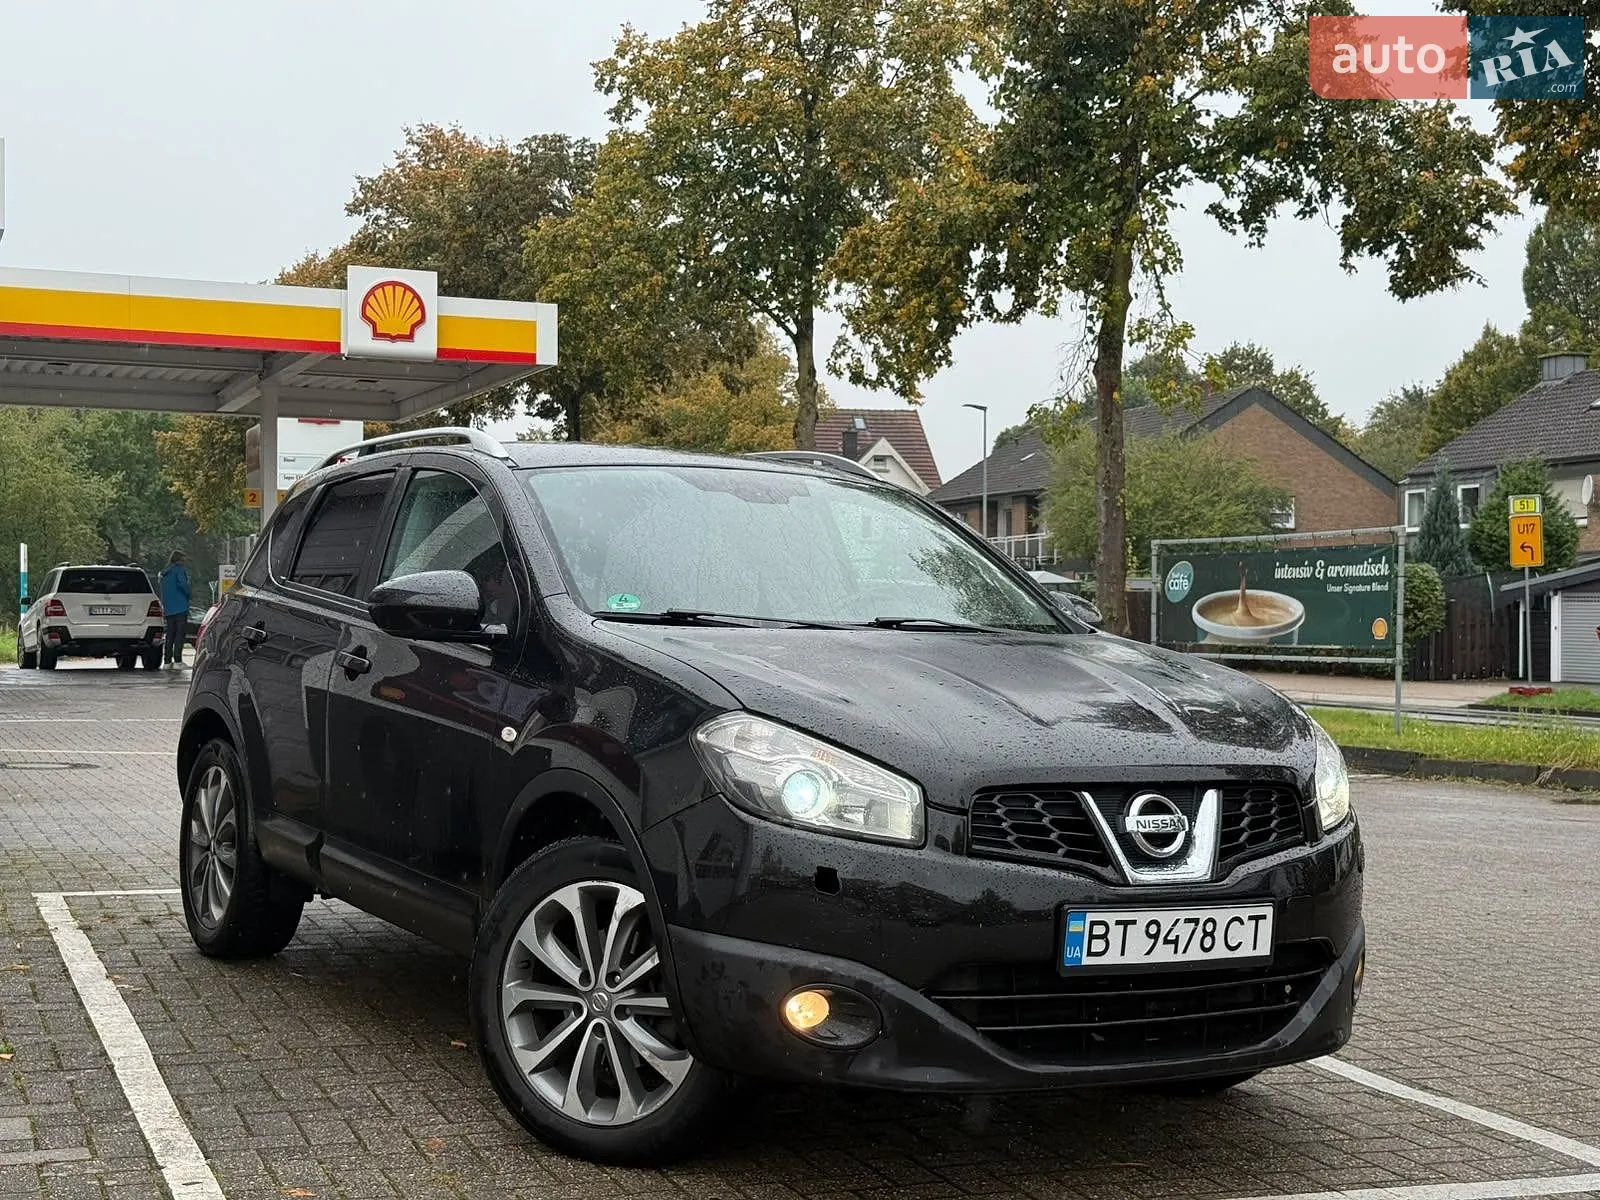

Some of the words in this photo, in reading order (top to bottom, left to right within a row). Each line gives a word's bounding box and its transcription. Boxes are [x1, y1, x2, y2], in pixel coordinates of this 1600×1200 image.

[248, 492, 257, 503] 2
[1519, 500, 1529, 510] 51
[1517, 523, 1536, 535] U17
[1274, 561, 1313, 579] intensiv
[1315, 559, 1325, 579] &
[1327, 555, 1390, 577] aromatisch
[1168, 574, 1189, 591] café
[1326, 583, 1343, 593] Unser
[1343, 582, 1371, 595] Signature
[1371, 581, 1389, 592] Blend
[618, 594, 629, 603] 4
[1136, 818, 1185, 829] NISSAN
[1086, 919, 1137, 957] BT
[1143, 916, 1218, 956] 9478
[1223, 914, 1268, 952] CT
[1066, 946, 1081, 958] UA
